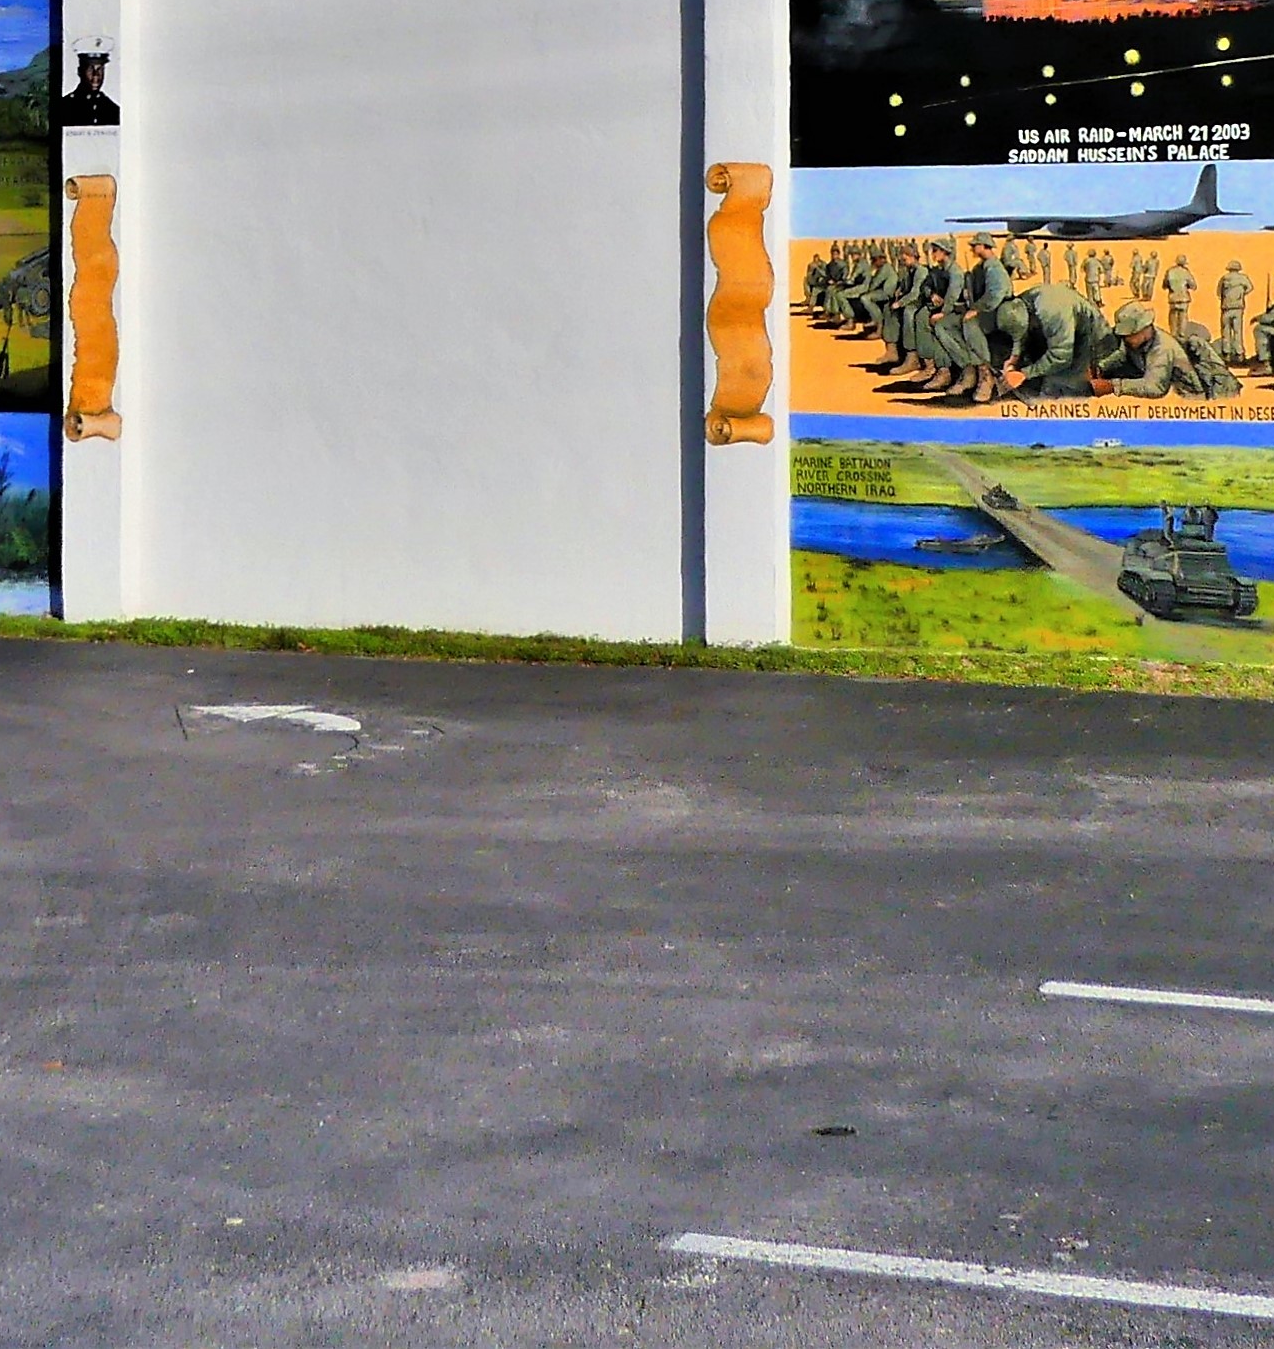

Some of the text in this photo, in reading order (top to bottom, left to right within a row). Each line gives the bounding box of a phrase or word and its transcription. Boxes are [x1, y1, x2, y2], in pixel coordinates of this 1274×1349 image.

[1018, 129, 1040, 144] US
[1043, 128, 1071, 144] AIR
[1188, 125, 1209, 142] 21
[1211, 123, 1251, 141] 2003
[1007, 143, 1231, 164] SADDAM HUSSEIN'S PALACE
[1000, 403, 1019, 418] US
[1026, 403, 1091, 418] MARINES
[1096, 404, 1141, 419] AWAIT
[1147, 404, 1227, 420] DEPLOYMENT
[1229, 405, 1244, 421] IN
[792, 455, 892, 470] MARINE BATTALION
[796, 468, 893, 483] RIVER CROSSING
[796, 482, 897, 497] NORTHERN IRAQ
